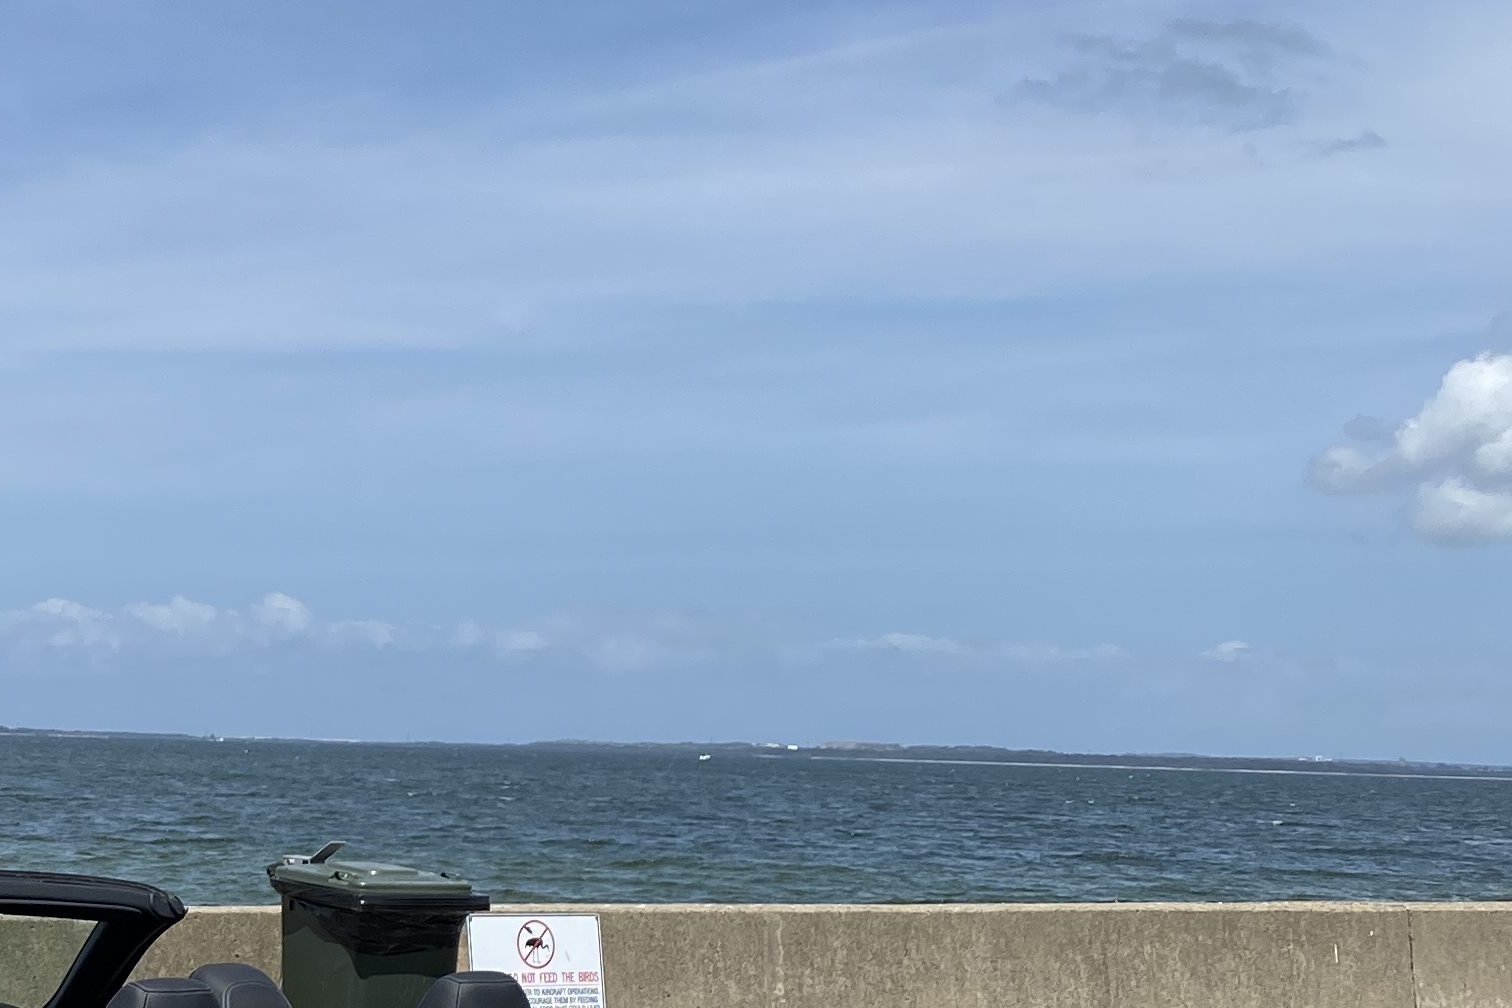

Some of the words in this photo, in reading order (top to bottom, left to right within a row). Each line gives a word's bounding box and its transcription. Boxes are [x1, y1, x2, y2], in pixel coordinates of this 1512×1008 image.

[522, 972, 535, 983] NOT
[540, 972, 557, 983] FEED
[562, 971, 575, 982] THE
[579, 971, 600, 982] BIRDS
